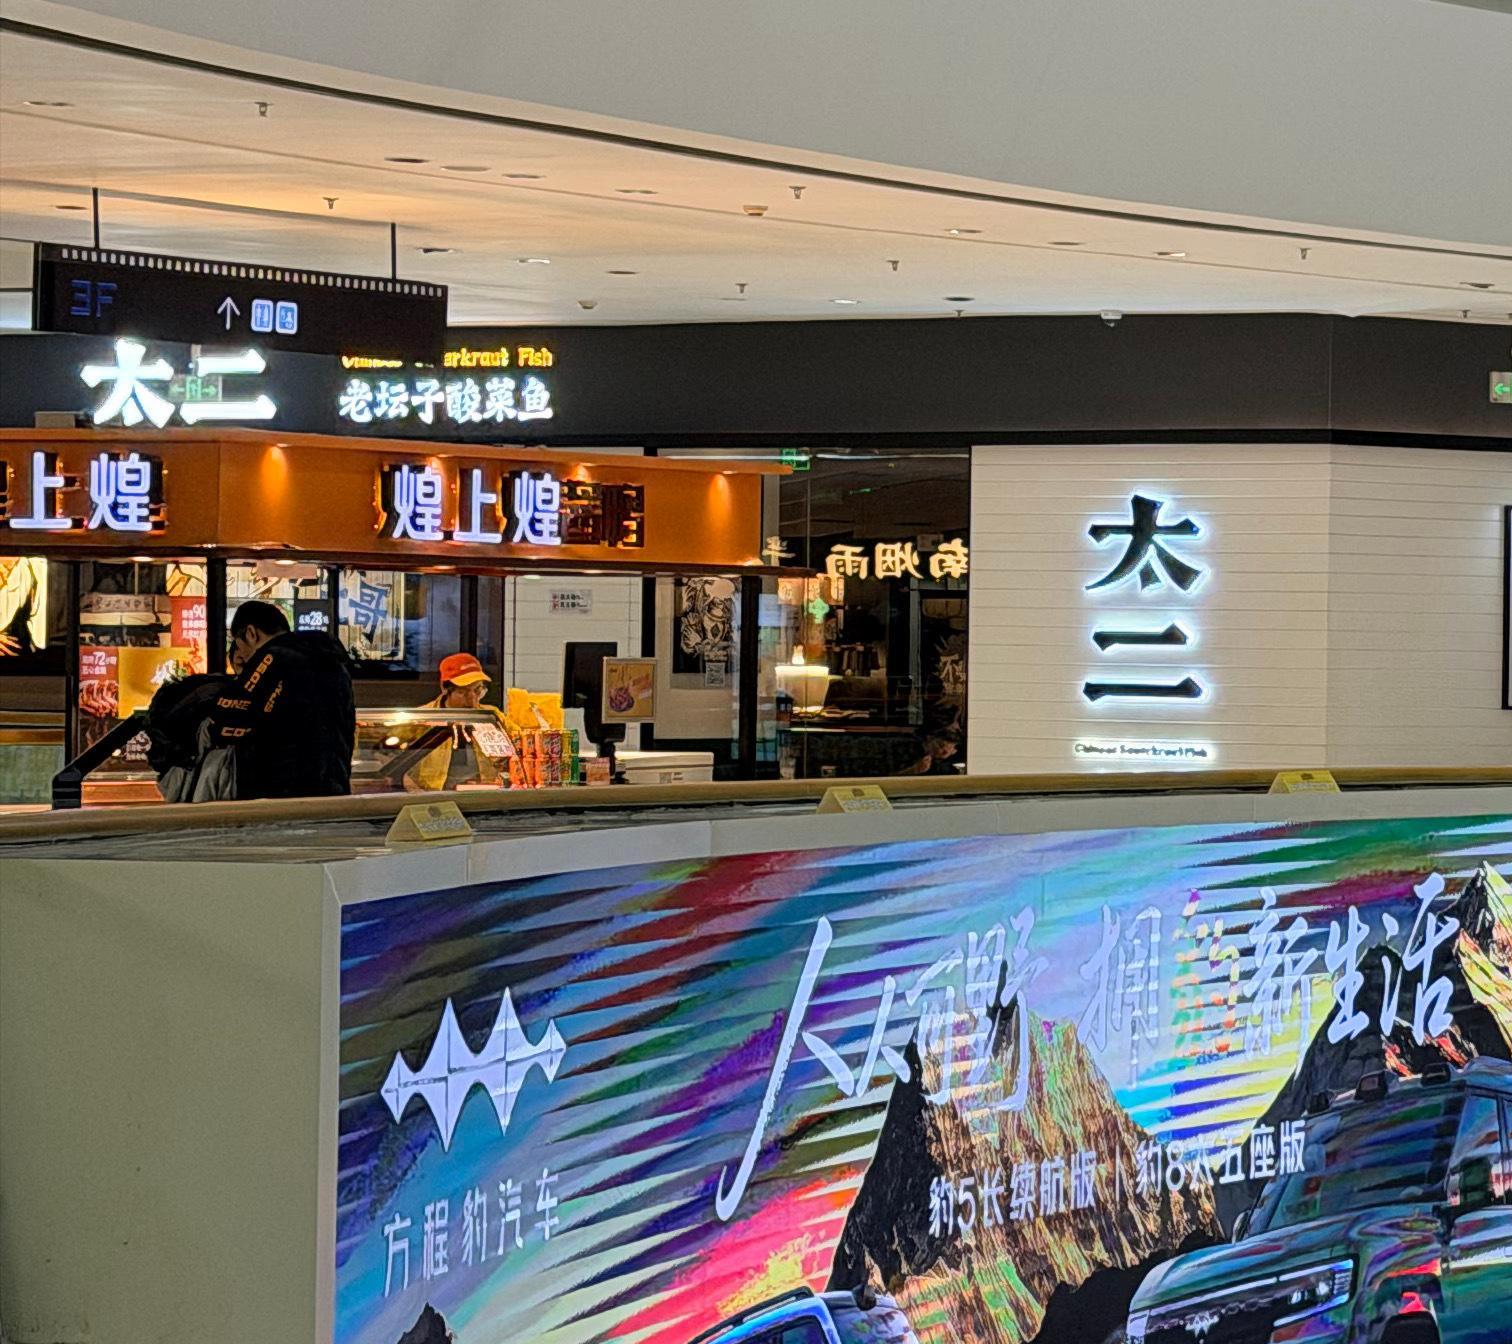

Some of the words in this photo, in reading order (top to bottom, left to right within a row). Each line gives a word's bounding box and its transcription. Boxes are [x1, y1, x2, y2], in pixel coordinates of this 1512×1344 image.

[70, 279, 118, 317] 3F
[80, 338, 277, 429] 太二
[338, 375, 554, 425] 老坛子酸菜鱼
[9, 451, 153, 532] 上煌
[392, 463, 562, 546] 煌上煌
[1083, 493, 1204, 702] 太二
[382, 1167, 562, 1299] 方程豹汽车
